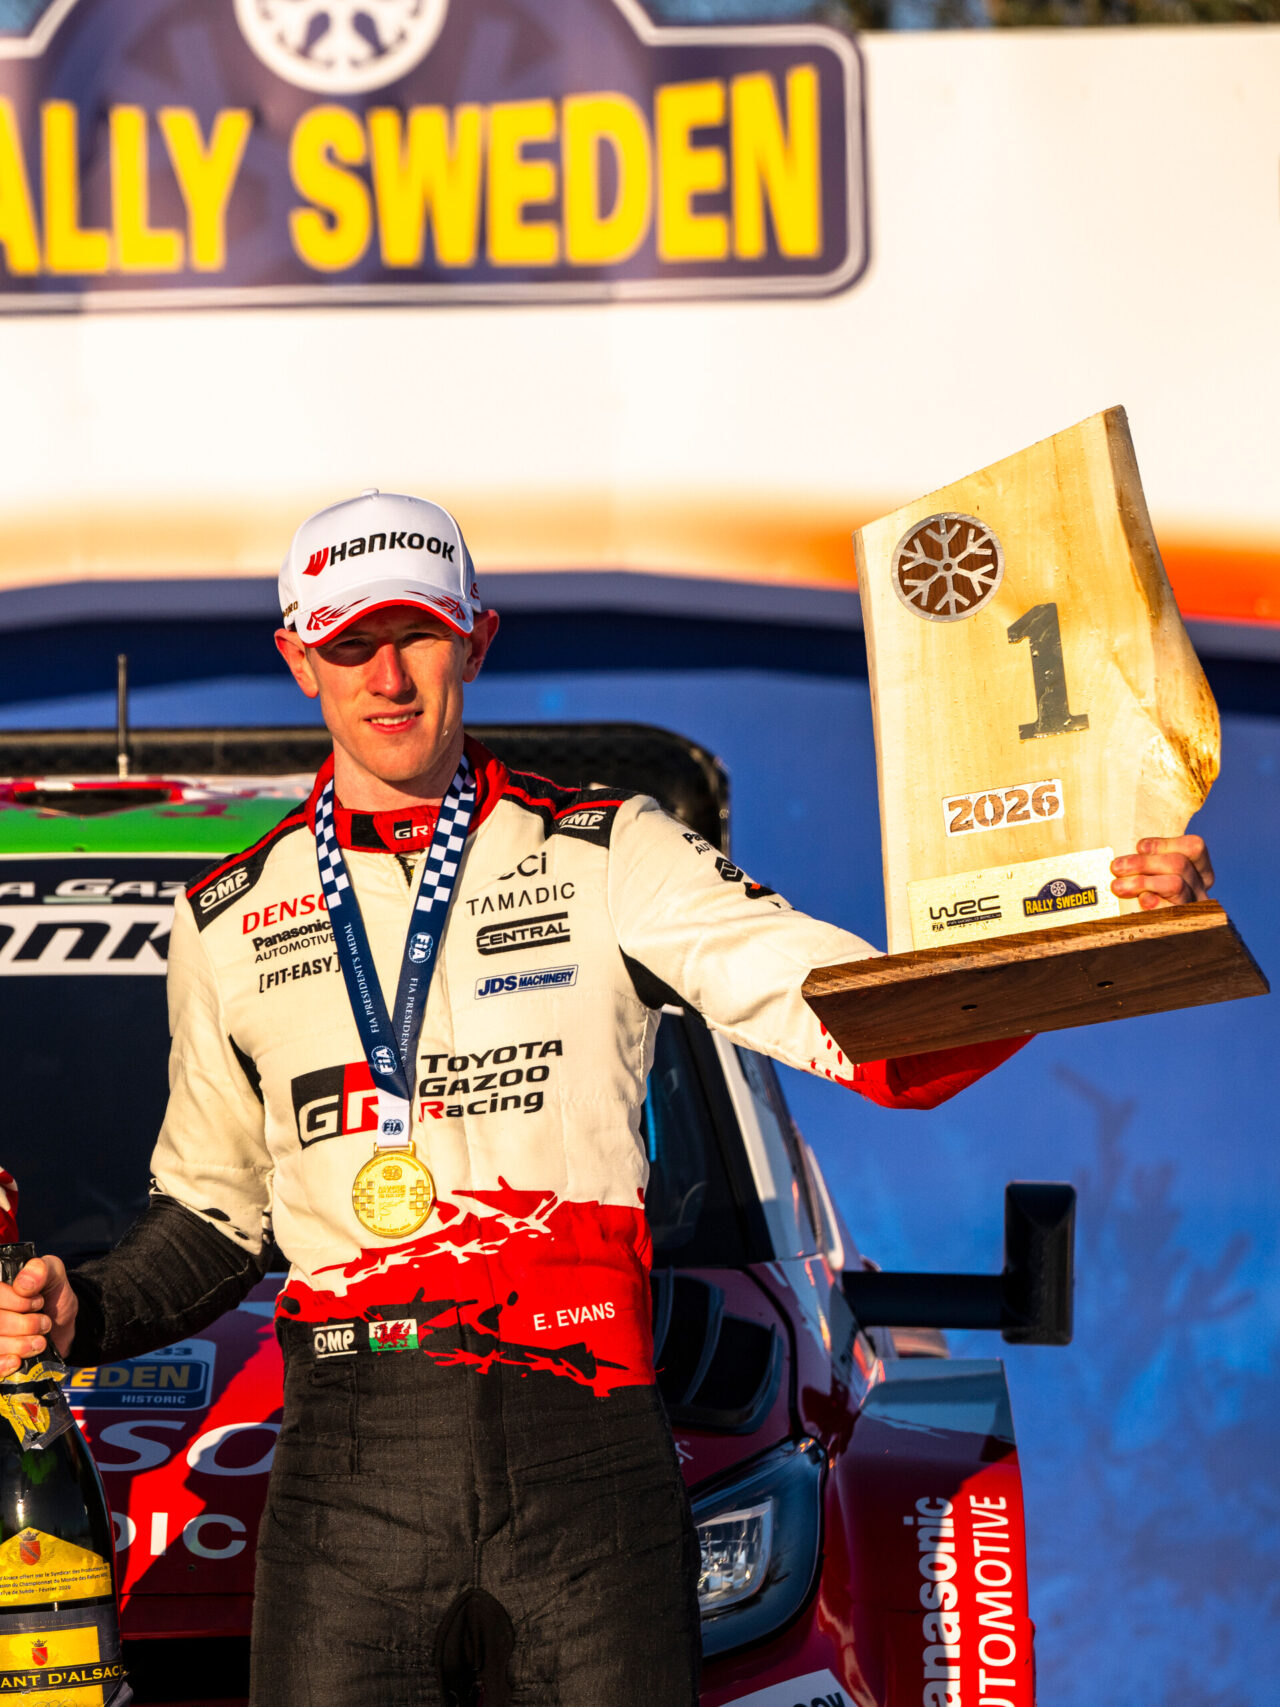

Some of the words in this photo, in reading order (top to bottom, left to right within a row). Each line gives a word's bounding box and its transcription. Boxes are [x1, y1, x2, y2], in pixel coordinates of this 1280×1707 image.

[290, 64, 823, 271] SWEDEN
[1007, 602, 1090, 741] 1
[948, 784, 1060, 833] 2026
[394, 825, 428, 840] GR
[200, 871, 249, 908] OMP
[466, 882, 576, 916] TAMADIC
[1025, 898, 1053, 914] RALLY
[1056, 888, 1096, 910] SWEDEN
[929, 895, 1001, 921] WRC
[252, 919, 332, 952] Panasonic
[255, 932, 335, 964] AUTOMOTIVE
[343, 921, 360, 956] MEDAL
[476, 922, 570, 949] CENTRAL
[351, 956, 376, 1016] PRESIDENT'S
[408, 977, 419, 994] FIA
[478, 974, 519, 997] JDS
[519, 970, 574, 988] MACHINERY
[370, 1017, 380, 1033] FIA
[421, 1039, 563, 1074] TOYOTA
[420, 1065, 550, 1097] GAZOO
[419, 1091, 544, 1122] Racing
[533, 1314, 552, 1331] E.
[557, 1301, 616, 1327] EVANS
[314, 1328, 355, 1353] OMP
[70, 1365, 190, 1389] EDEN
[121, 1394, 187, 1405] HISTORIC
[903, 1497, 961, 1707] anasonic
[969, 1495, 1017, 1707] TOMOTIVE
